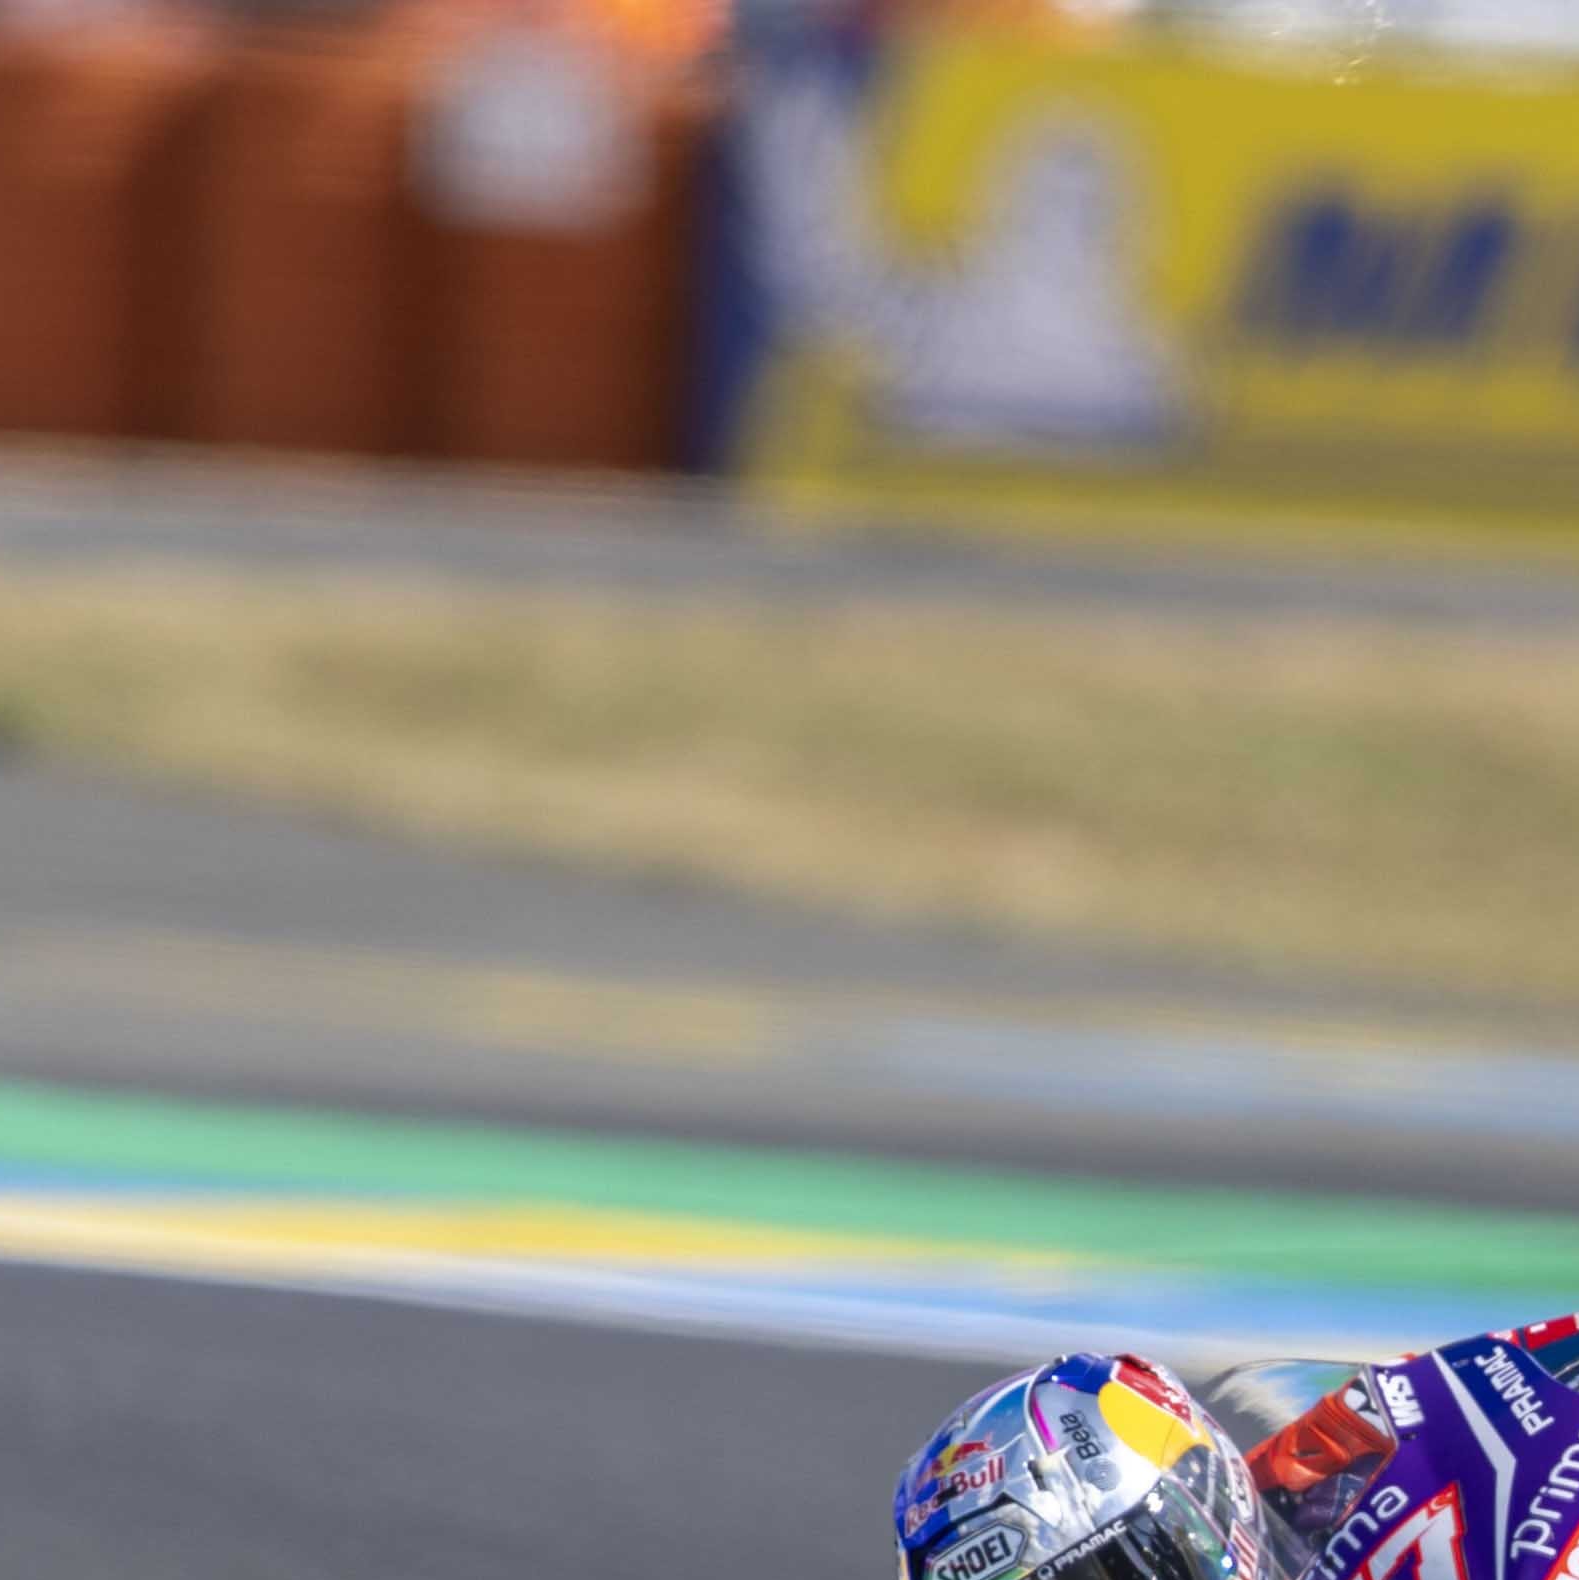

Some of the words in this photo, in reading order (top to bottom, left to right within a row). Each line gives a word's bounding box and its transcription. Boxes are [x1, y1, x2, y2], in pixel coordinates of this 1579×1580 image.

[1473, 1346, 1555, 1437] PRAMAC
[1060, 1413, 1102, 1460] Beta
[950, 1456, 1004, 1496] Bull
[1054, 1519, 1127, 1570] PRAMAC
